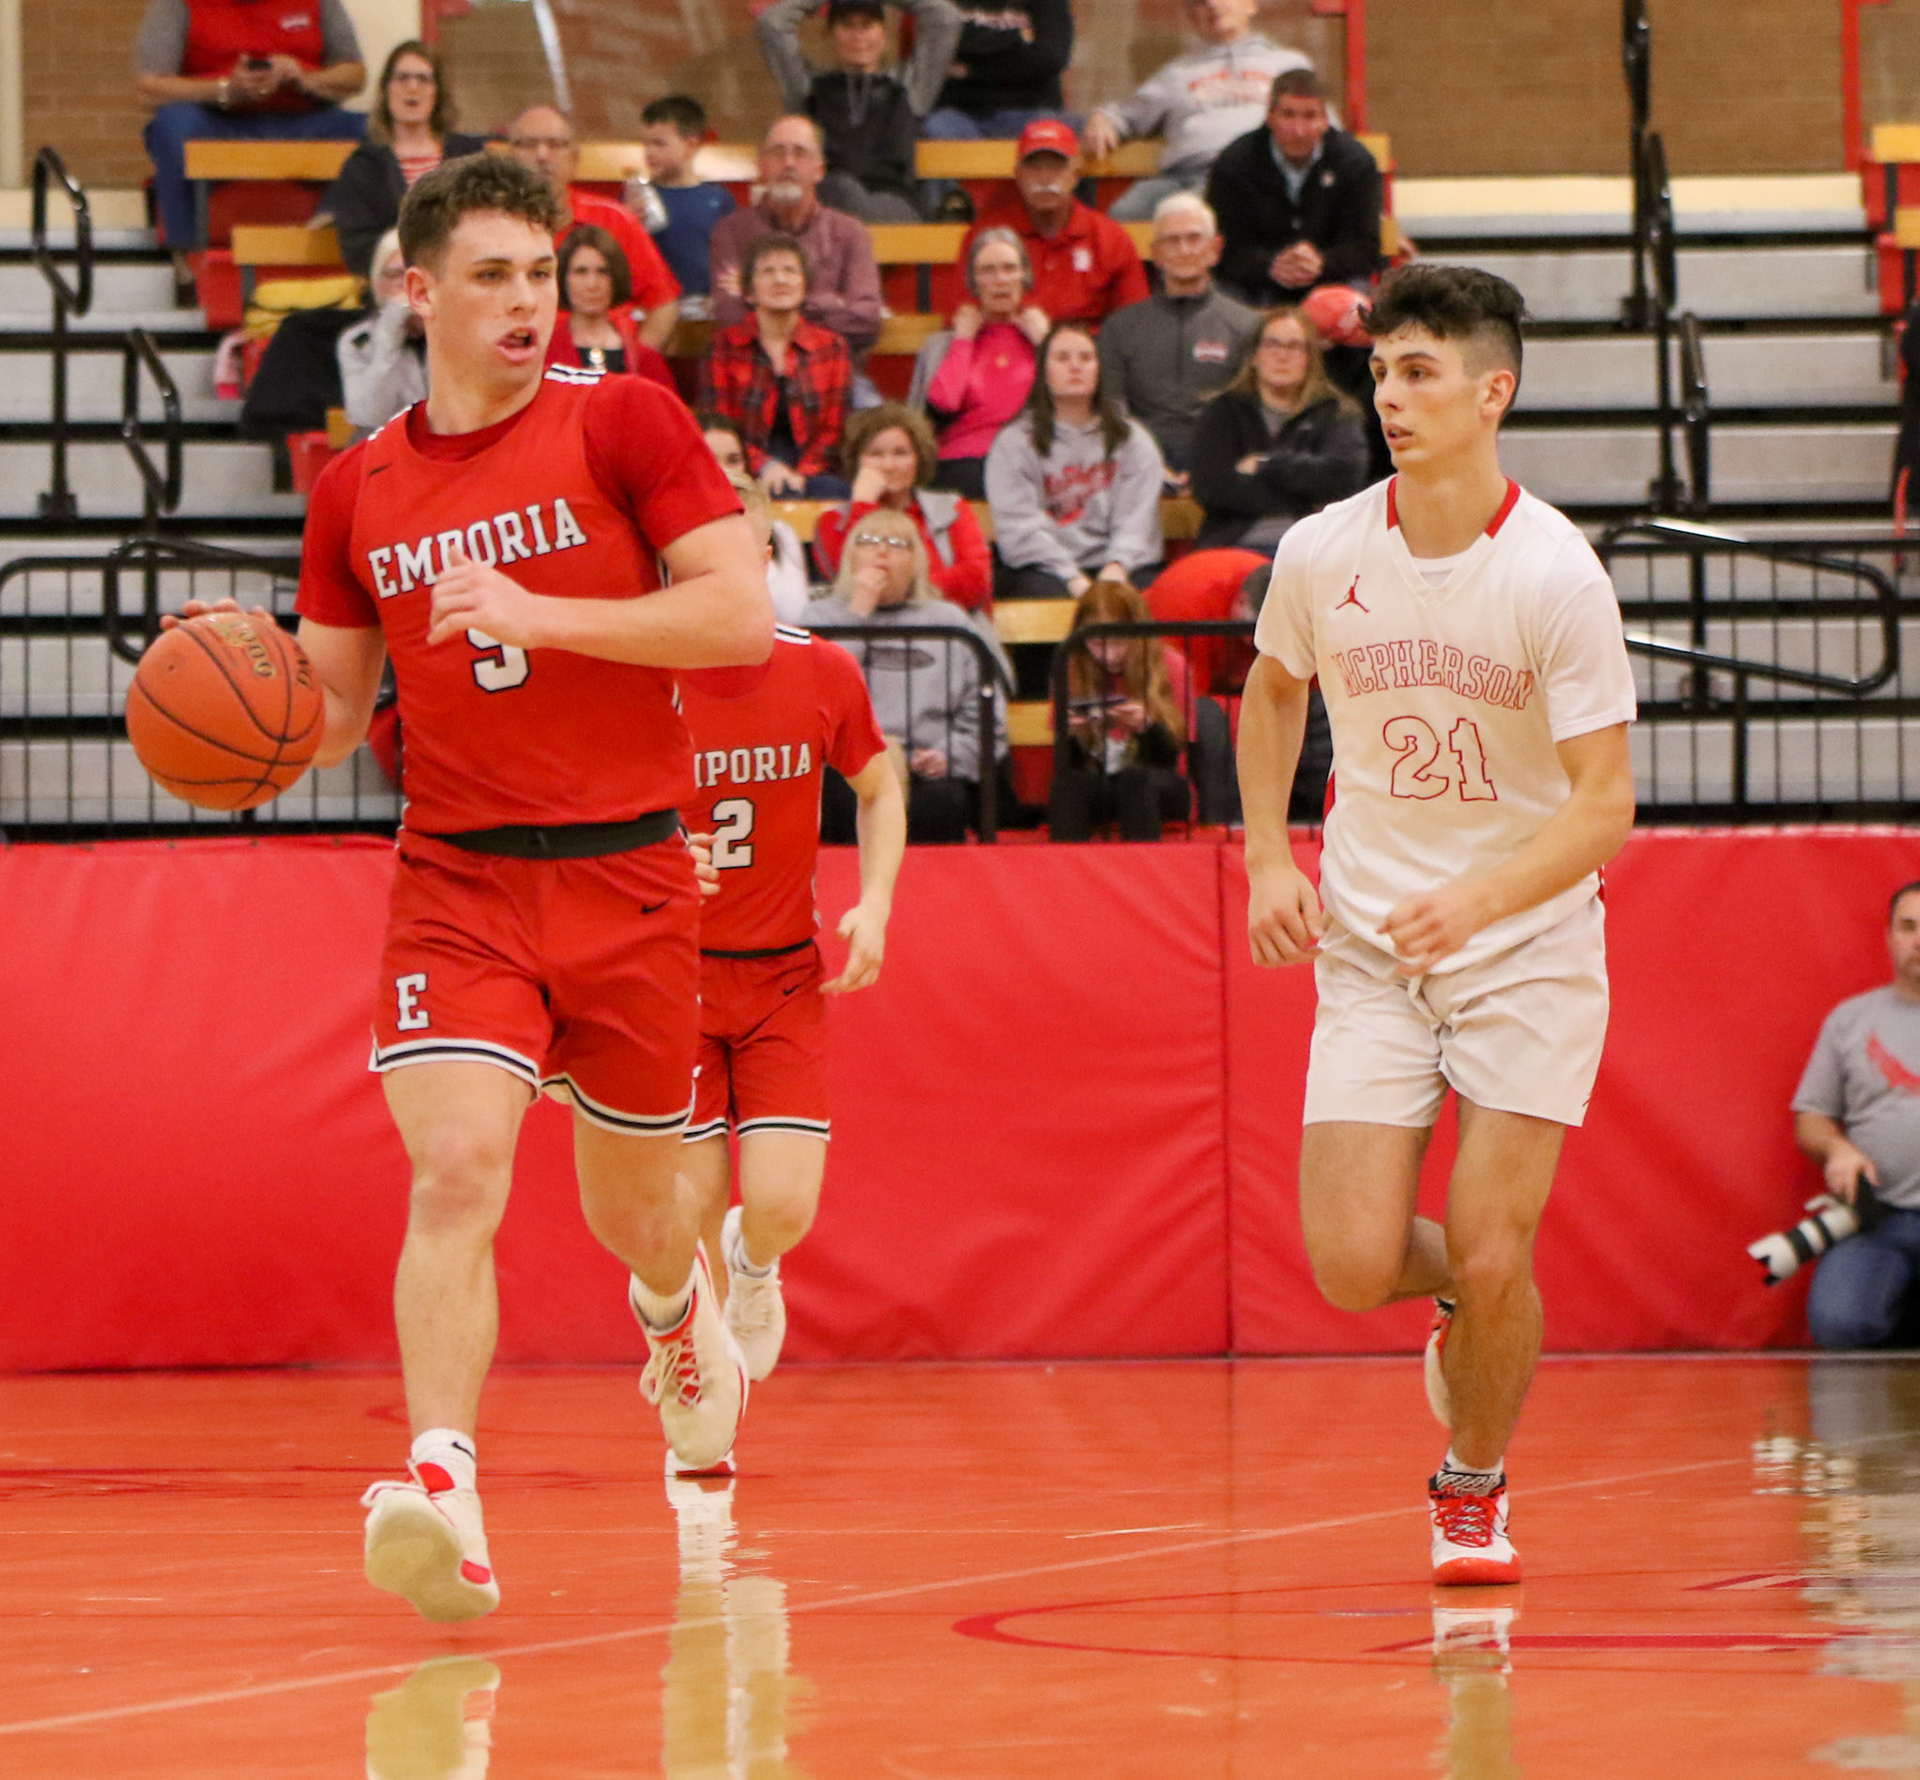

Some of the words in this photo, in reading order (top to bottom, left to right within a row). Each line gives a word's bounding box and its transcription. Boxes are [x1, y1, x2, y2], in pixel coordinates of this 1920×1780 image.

[368, 498, 587, 599] EMPORIA
[1331, 639, 1535, 710] MCPHERSON
[1383, 715, 1497, 802] 21
[711, 797, 756, 869] 2
[395, 973, 430, 1031] E
